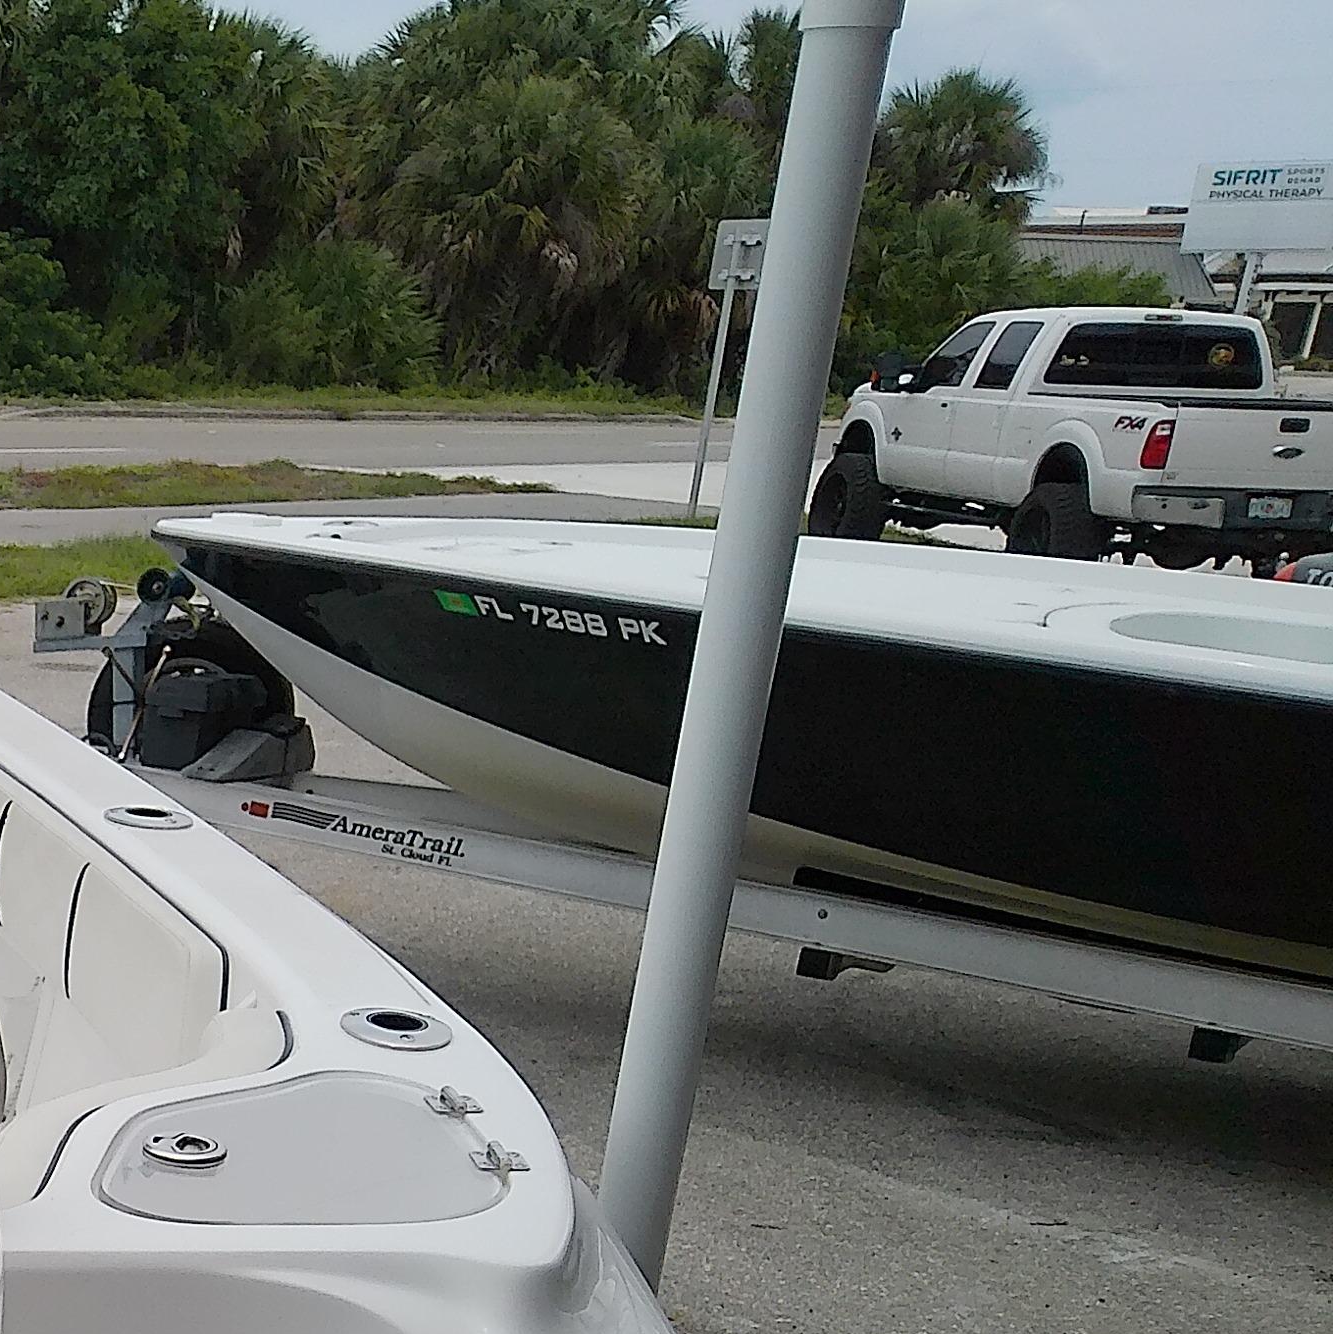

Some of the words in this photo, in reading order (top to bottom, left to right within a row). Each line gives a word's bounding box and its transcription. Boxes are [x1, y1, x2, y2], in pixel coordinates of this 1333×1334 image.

[1212, 168, 1283, 186] SIFRIT
[1208, 189, 1265, 199] PHYSICAL
[1269, 187, 1325, 199] THERAPY
[1114, 415, 1149, 431] FX4
[473, 594, 514, 621] FL
[519, 602, 608, 637] 7288
[617, 616, 668, 646] PK
[400, 847, 434, 863] Cloud
